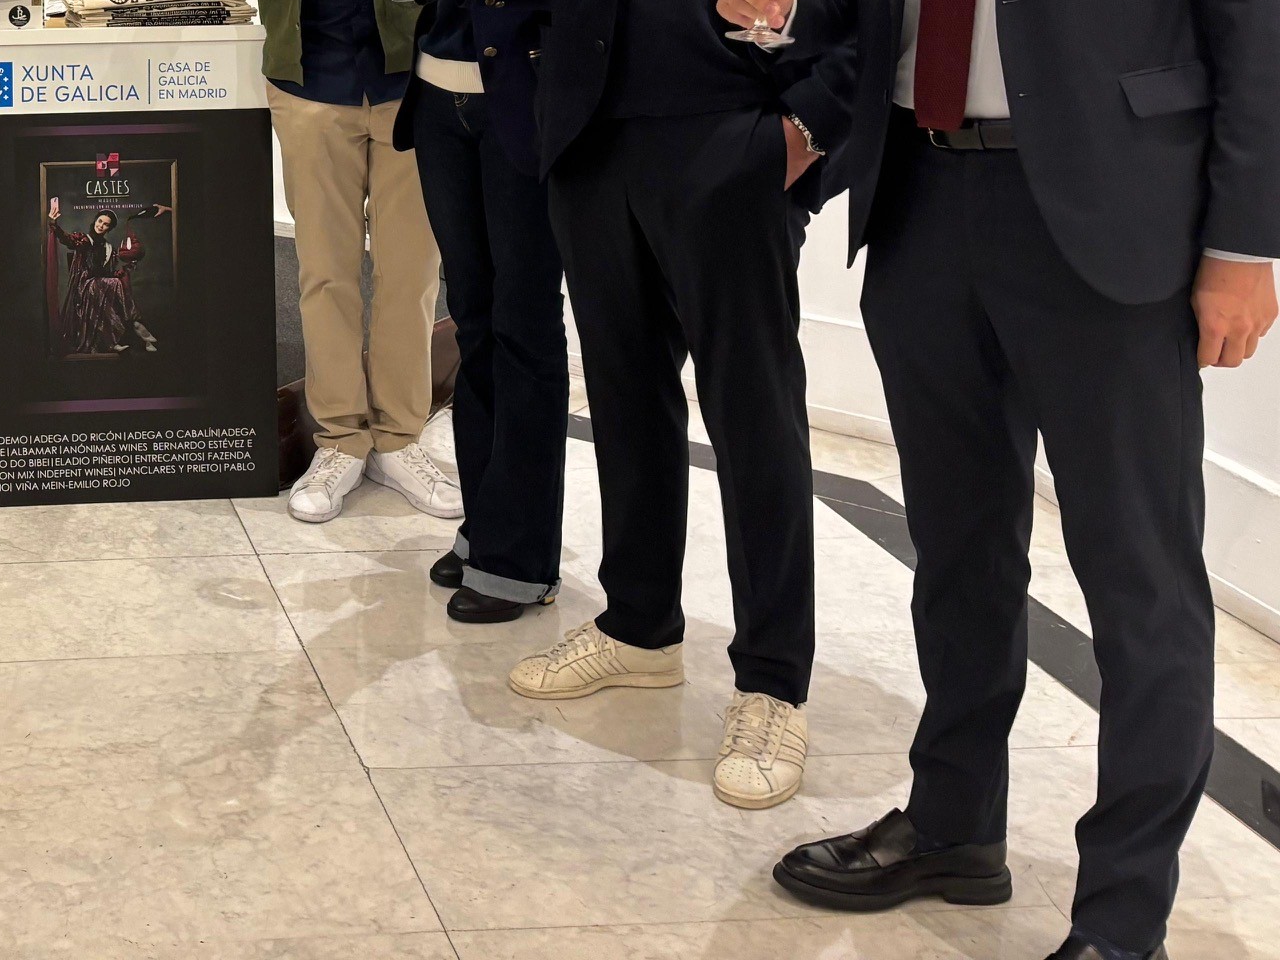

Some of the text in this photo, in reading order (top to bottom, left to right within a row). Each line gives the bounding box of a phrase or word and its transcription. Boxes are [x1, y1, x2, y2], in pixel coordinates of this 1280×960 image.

[22, 64, 94, 82] XUNTA
[158, 62, 211, 73] CASA DE
[158, 75, 208, 87] GALICIA
[21, 84, 140, 102] DE GALICIA
[158, 88, 227, 99] EN MADRID
[86, 180, 130, 195] CASTES
[33, 435, 68, 445] ADEGA
[71, 434, 87, 443] DO
[90, 431, 121, 442] RICÓN
[127, 431, 162, 441] ADEGA
[165, 431, 173, 439] O
[176, 427, 218, 439] CABALÍN
[221, 428, 256, 437] ADEGA
[10, 446, 57, 456] ALBAMAR
[62, 442, 116, 454] ANÓNIMAS
[118, 442, 147, 452] WINES
[152, 440, 205, 450] BERNARDO
[208, 436, 244, 448] ESTÉVEZ
[247, 438, 252, 446] E
[10, 460, 26, 468] DO
[28, 459, 49, 467] BIBEI
[54, 457, 90, 466] ELADIO
[92, 453, 129, 465] PIÑEIRO
[134, 452, 202, 463] ENTRECANTOS
[207, 450, 250, 460] FAZENDA
[17, 471, 34, 480] MIX
[37, 469, 80, 479] INDEPENT
[84, 468, 112, 477] WINES
[118, 465, 175, 475] NANCLARES
[178, 465, 183, 473] Y
[186, 463, 218, 472] PRIETO
[223, 462, 255, 471] PABLO
[15, 481, 38, 492] VIÑA
[41, 480, 100, 491] MEIN-EMILIO
[102, 479, 130, 488] ROJO
